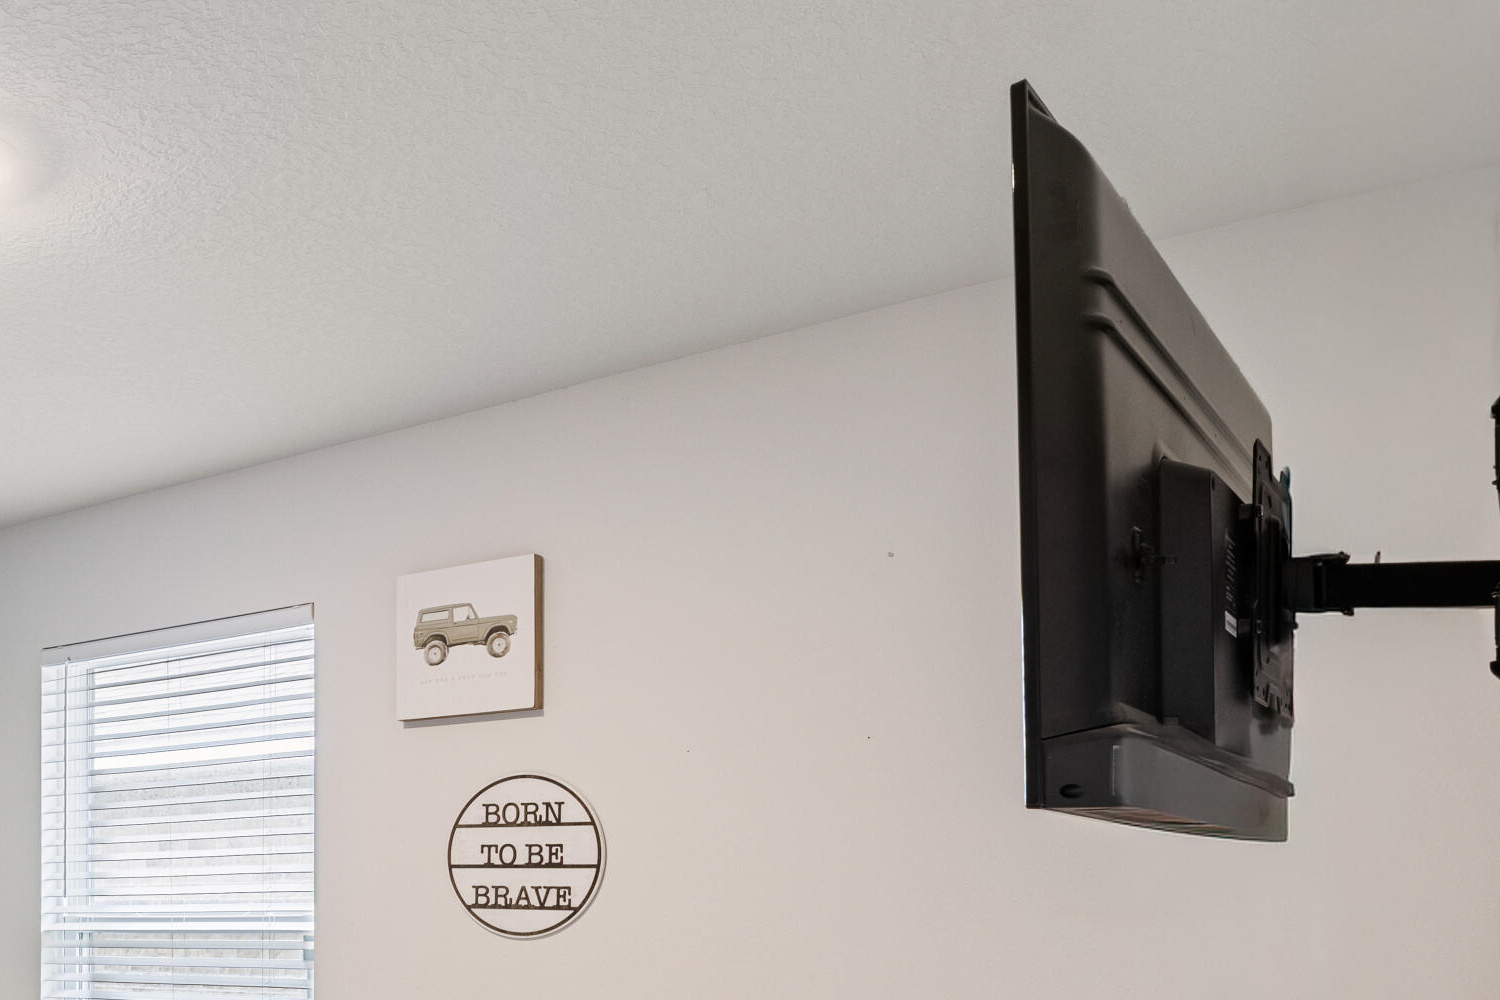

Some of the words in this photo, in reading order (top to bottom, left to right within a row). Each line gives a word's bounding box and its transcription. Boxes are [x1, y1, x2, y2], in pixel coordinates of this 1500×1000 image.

[482, 802, 565, 825] BORN
[480, 843, 518, 867] TO
[524, 843, 564, 867] BE
[471, 885, 572, 909] BRAVE
